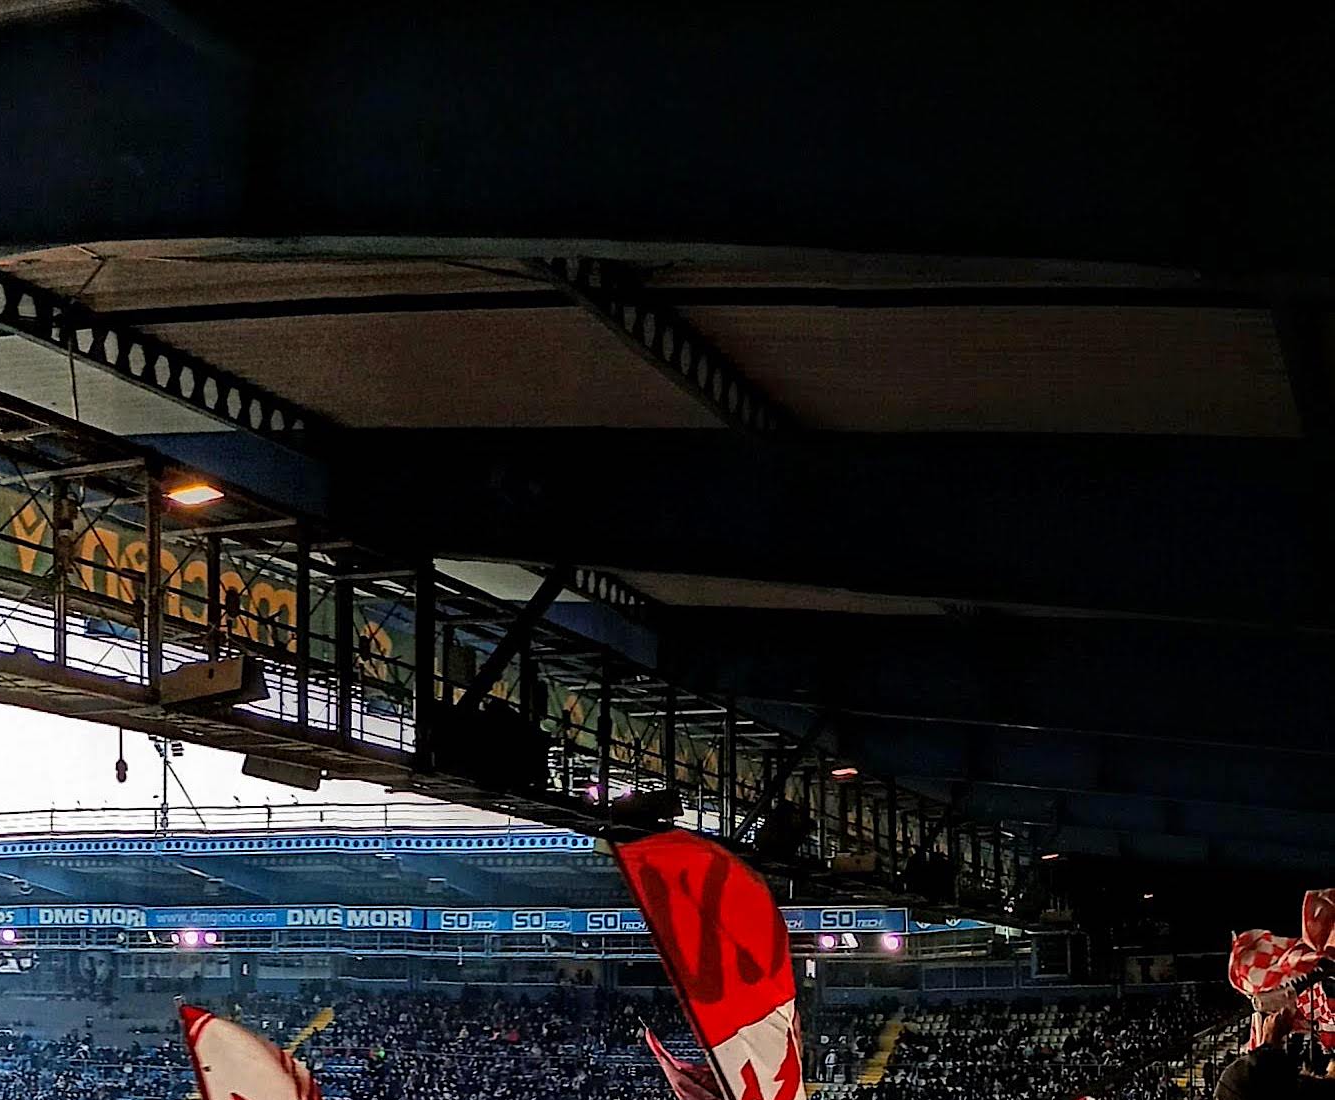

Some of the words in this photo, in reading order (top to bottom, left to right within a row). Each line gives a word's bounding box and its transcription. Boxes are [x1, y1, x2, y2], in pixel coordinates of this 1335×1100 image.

[38, 908, 89, 925] DMG
[92, 908, 147, 927] MORI
[156, 911, 277, 926] www.dmgmori.com
[287, 908, 343, 926] DMG
[347, 909, 413, 927] MORI
